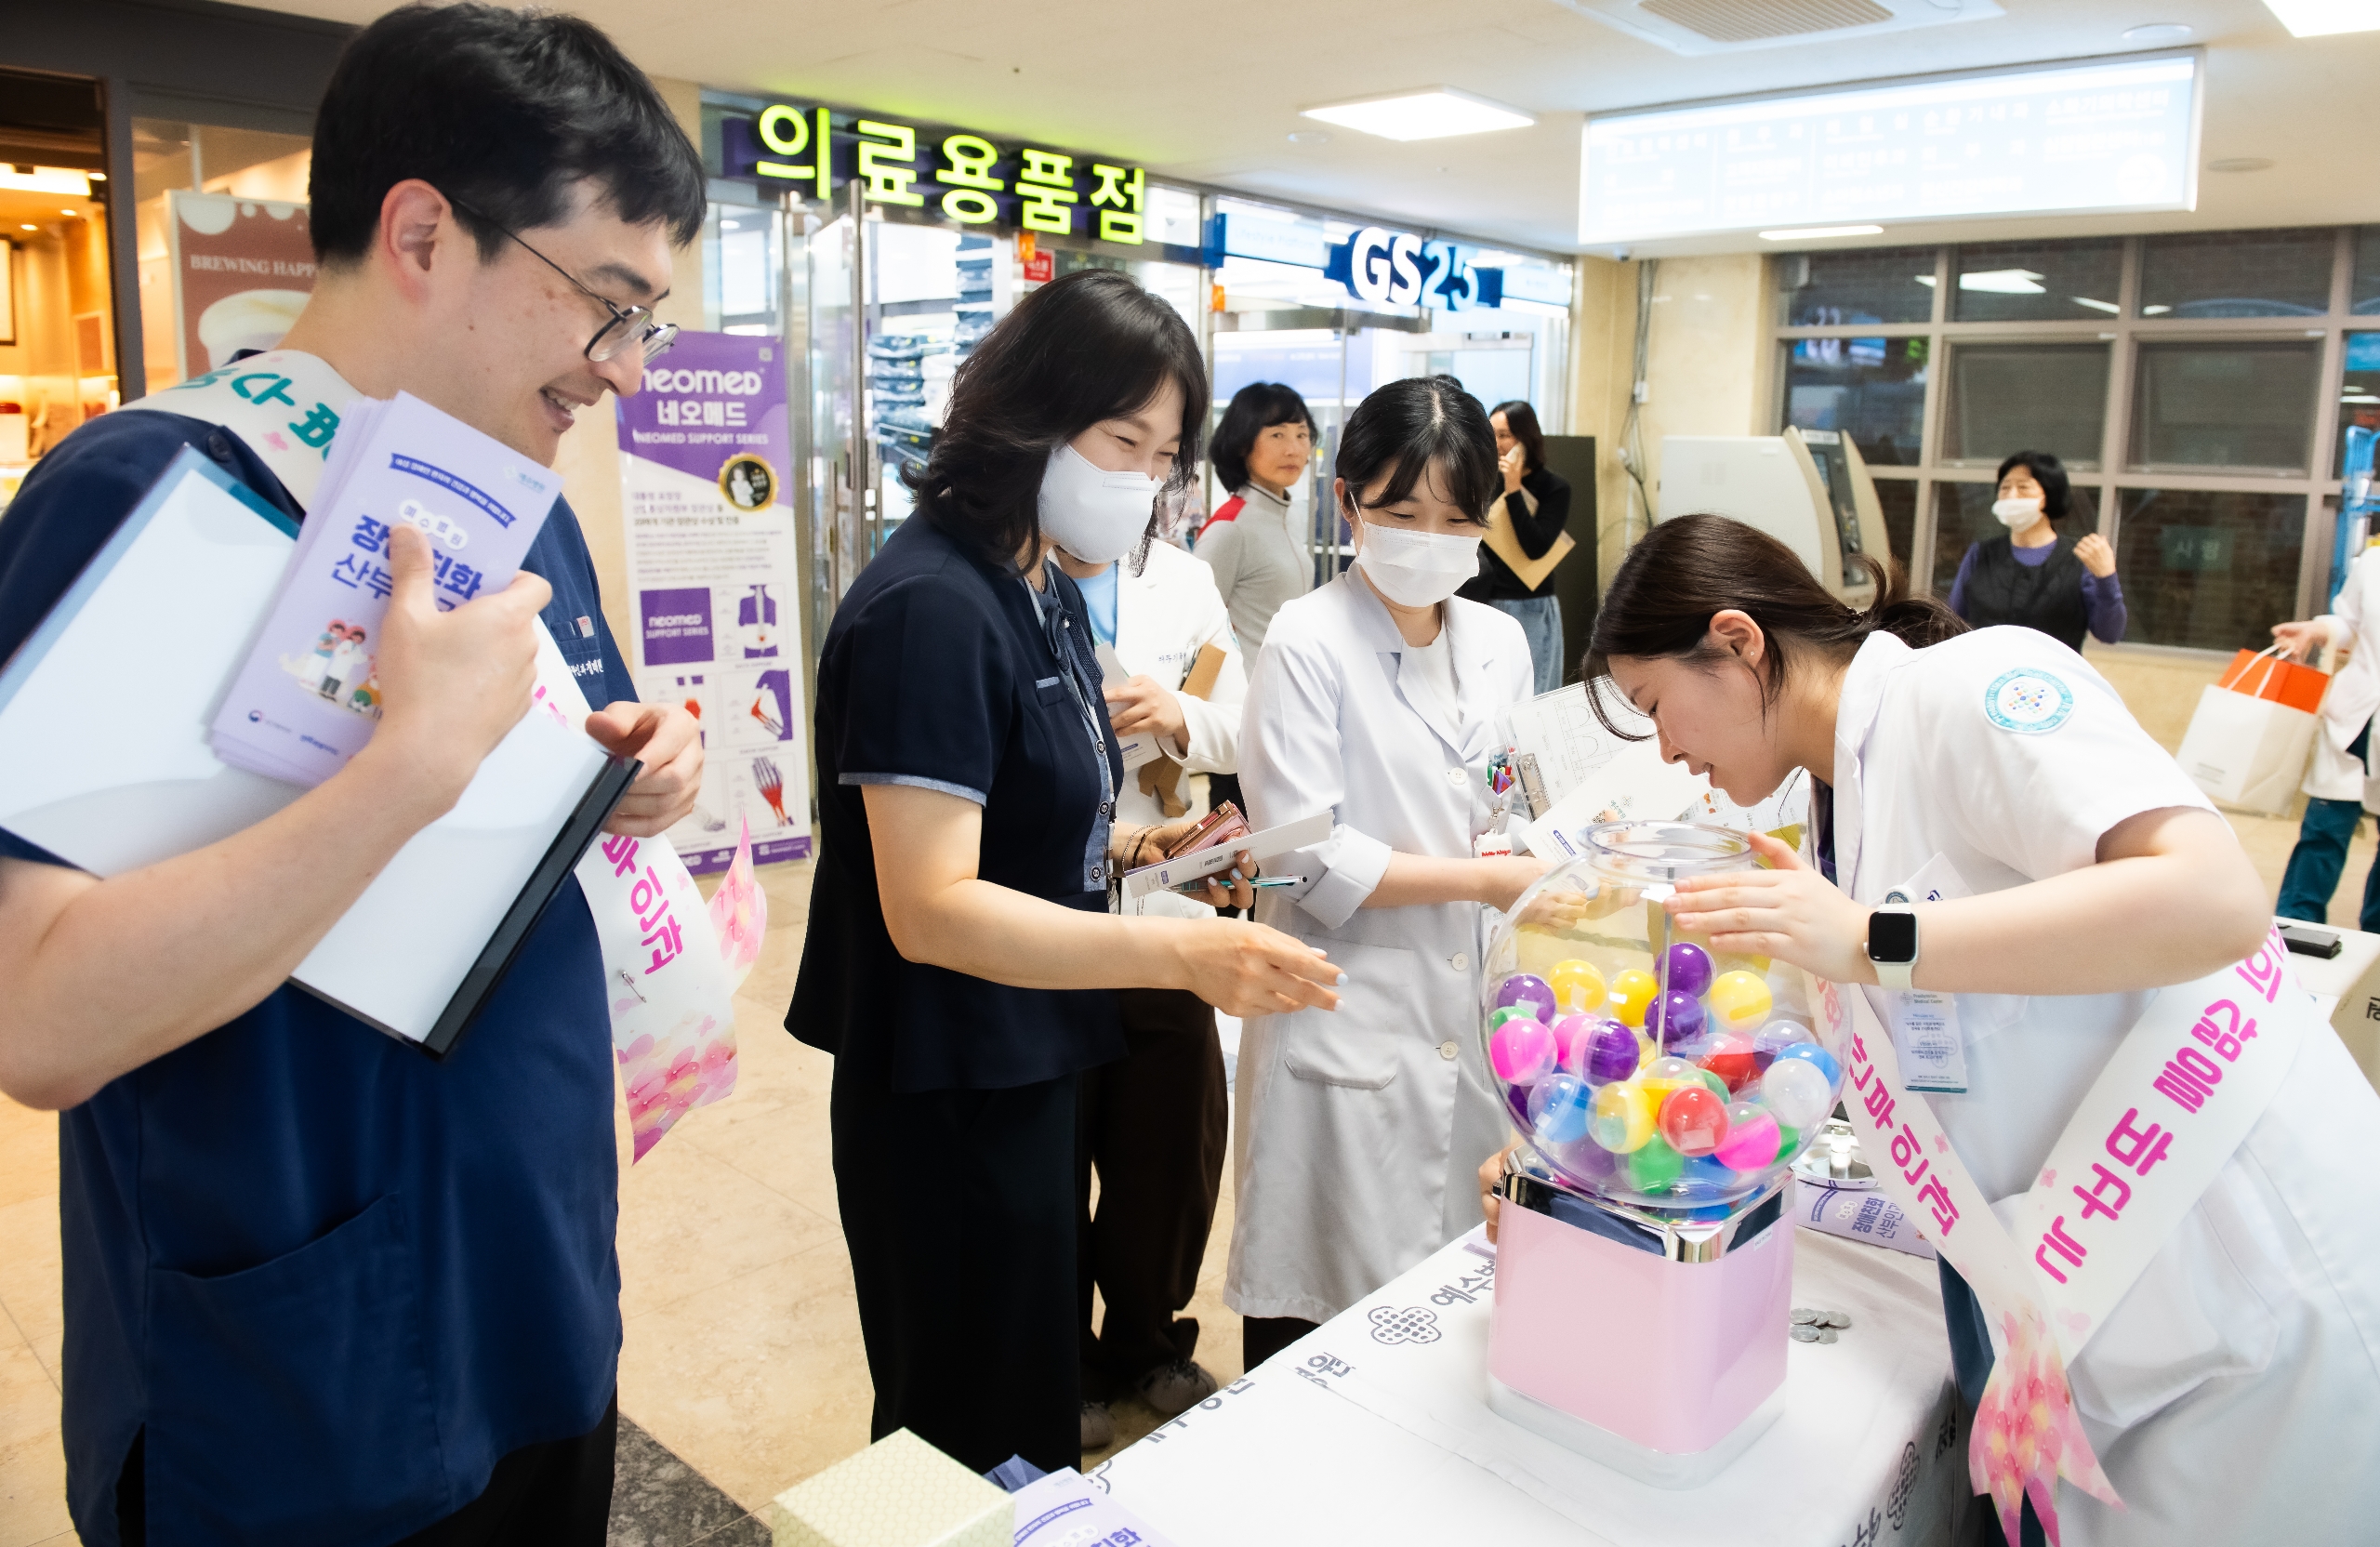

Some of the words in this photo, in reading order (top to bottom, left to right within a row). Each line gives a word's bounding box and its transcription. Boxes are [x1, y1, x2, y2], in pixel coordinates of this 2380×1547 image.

[756, 103, 1145, 245] 의료용품점
[190, 254, 271, 275] BREWING
[1352, 227, 1478, 312] GS25
[657, 400, 747, 427] 네오메드
[635, 432, 686, 444] NEOMED
[688, 432, 734, 444] SUPPORT
[735, 433, 769, 444] SERIES
[645, 628, 681, 640] SUPPORT
[681, 627, 709, 638] SERIES
[2152, 998, 2257, 1115] 삶을
[2035, 1107, 2175, 1285] 바꾸는
[1851, 1197, 1886, 1234] 장애친화
